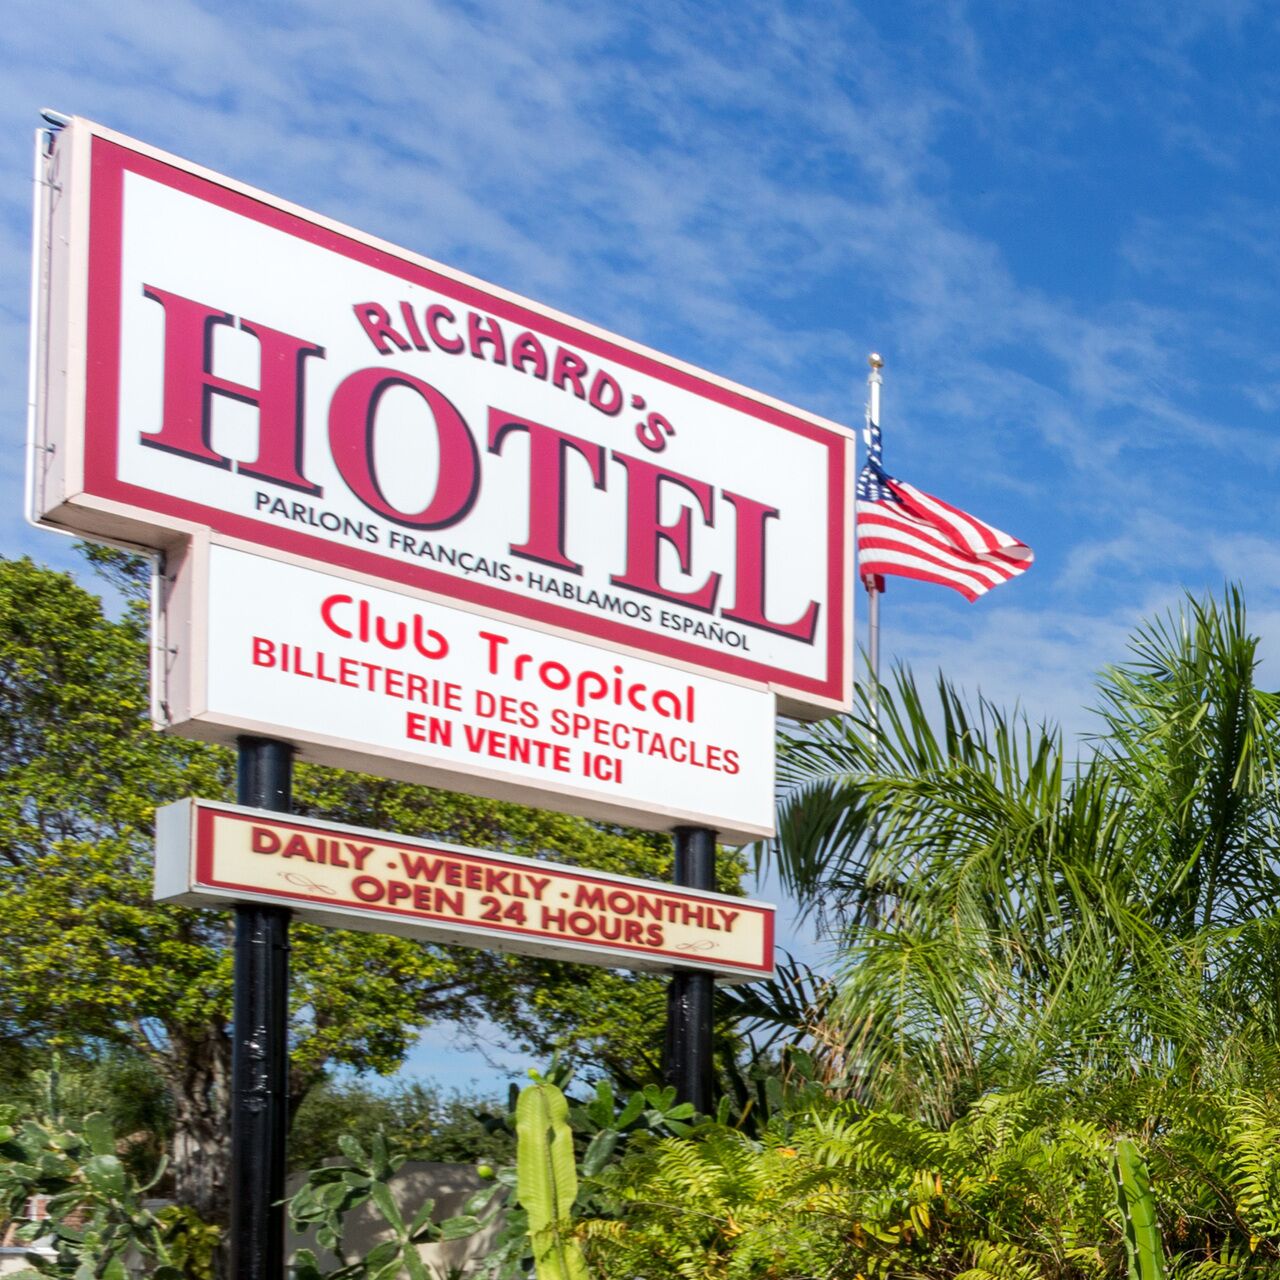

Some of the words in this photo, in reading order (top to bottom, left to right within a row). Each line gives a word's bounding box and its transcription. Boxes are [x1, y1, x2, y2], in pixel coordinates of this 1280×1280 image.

[353, 300, 676, 453] RICHARD'S
[139, 283, 821, 646] HOTEL
[256, 493, 379, 544] PARLONS
[528, 573, 651, 623] HABLAMOS
[661, 611, 750, 651] ESPAÑOL
[252, 637, 463, 711] BILLETERIE
[475, 689, 539, 729] DES
[551, 709, 740, 775] SPECTACLES
[321, 594, 449, 660] Club
[479, 631, 695, 723] Tropical
[406, 711, 452, 747] EN
[464, 725, 571, 771] VENTE
[583, 752, 623, 784] ICI
[251, 827, 373, 871] DAILY
[351, 875, 464, 918] OPEN
[479, 894, 527, 927] 24
[541, 906, 665, 949] HOURS
